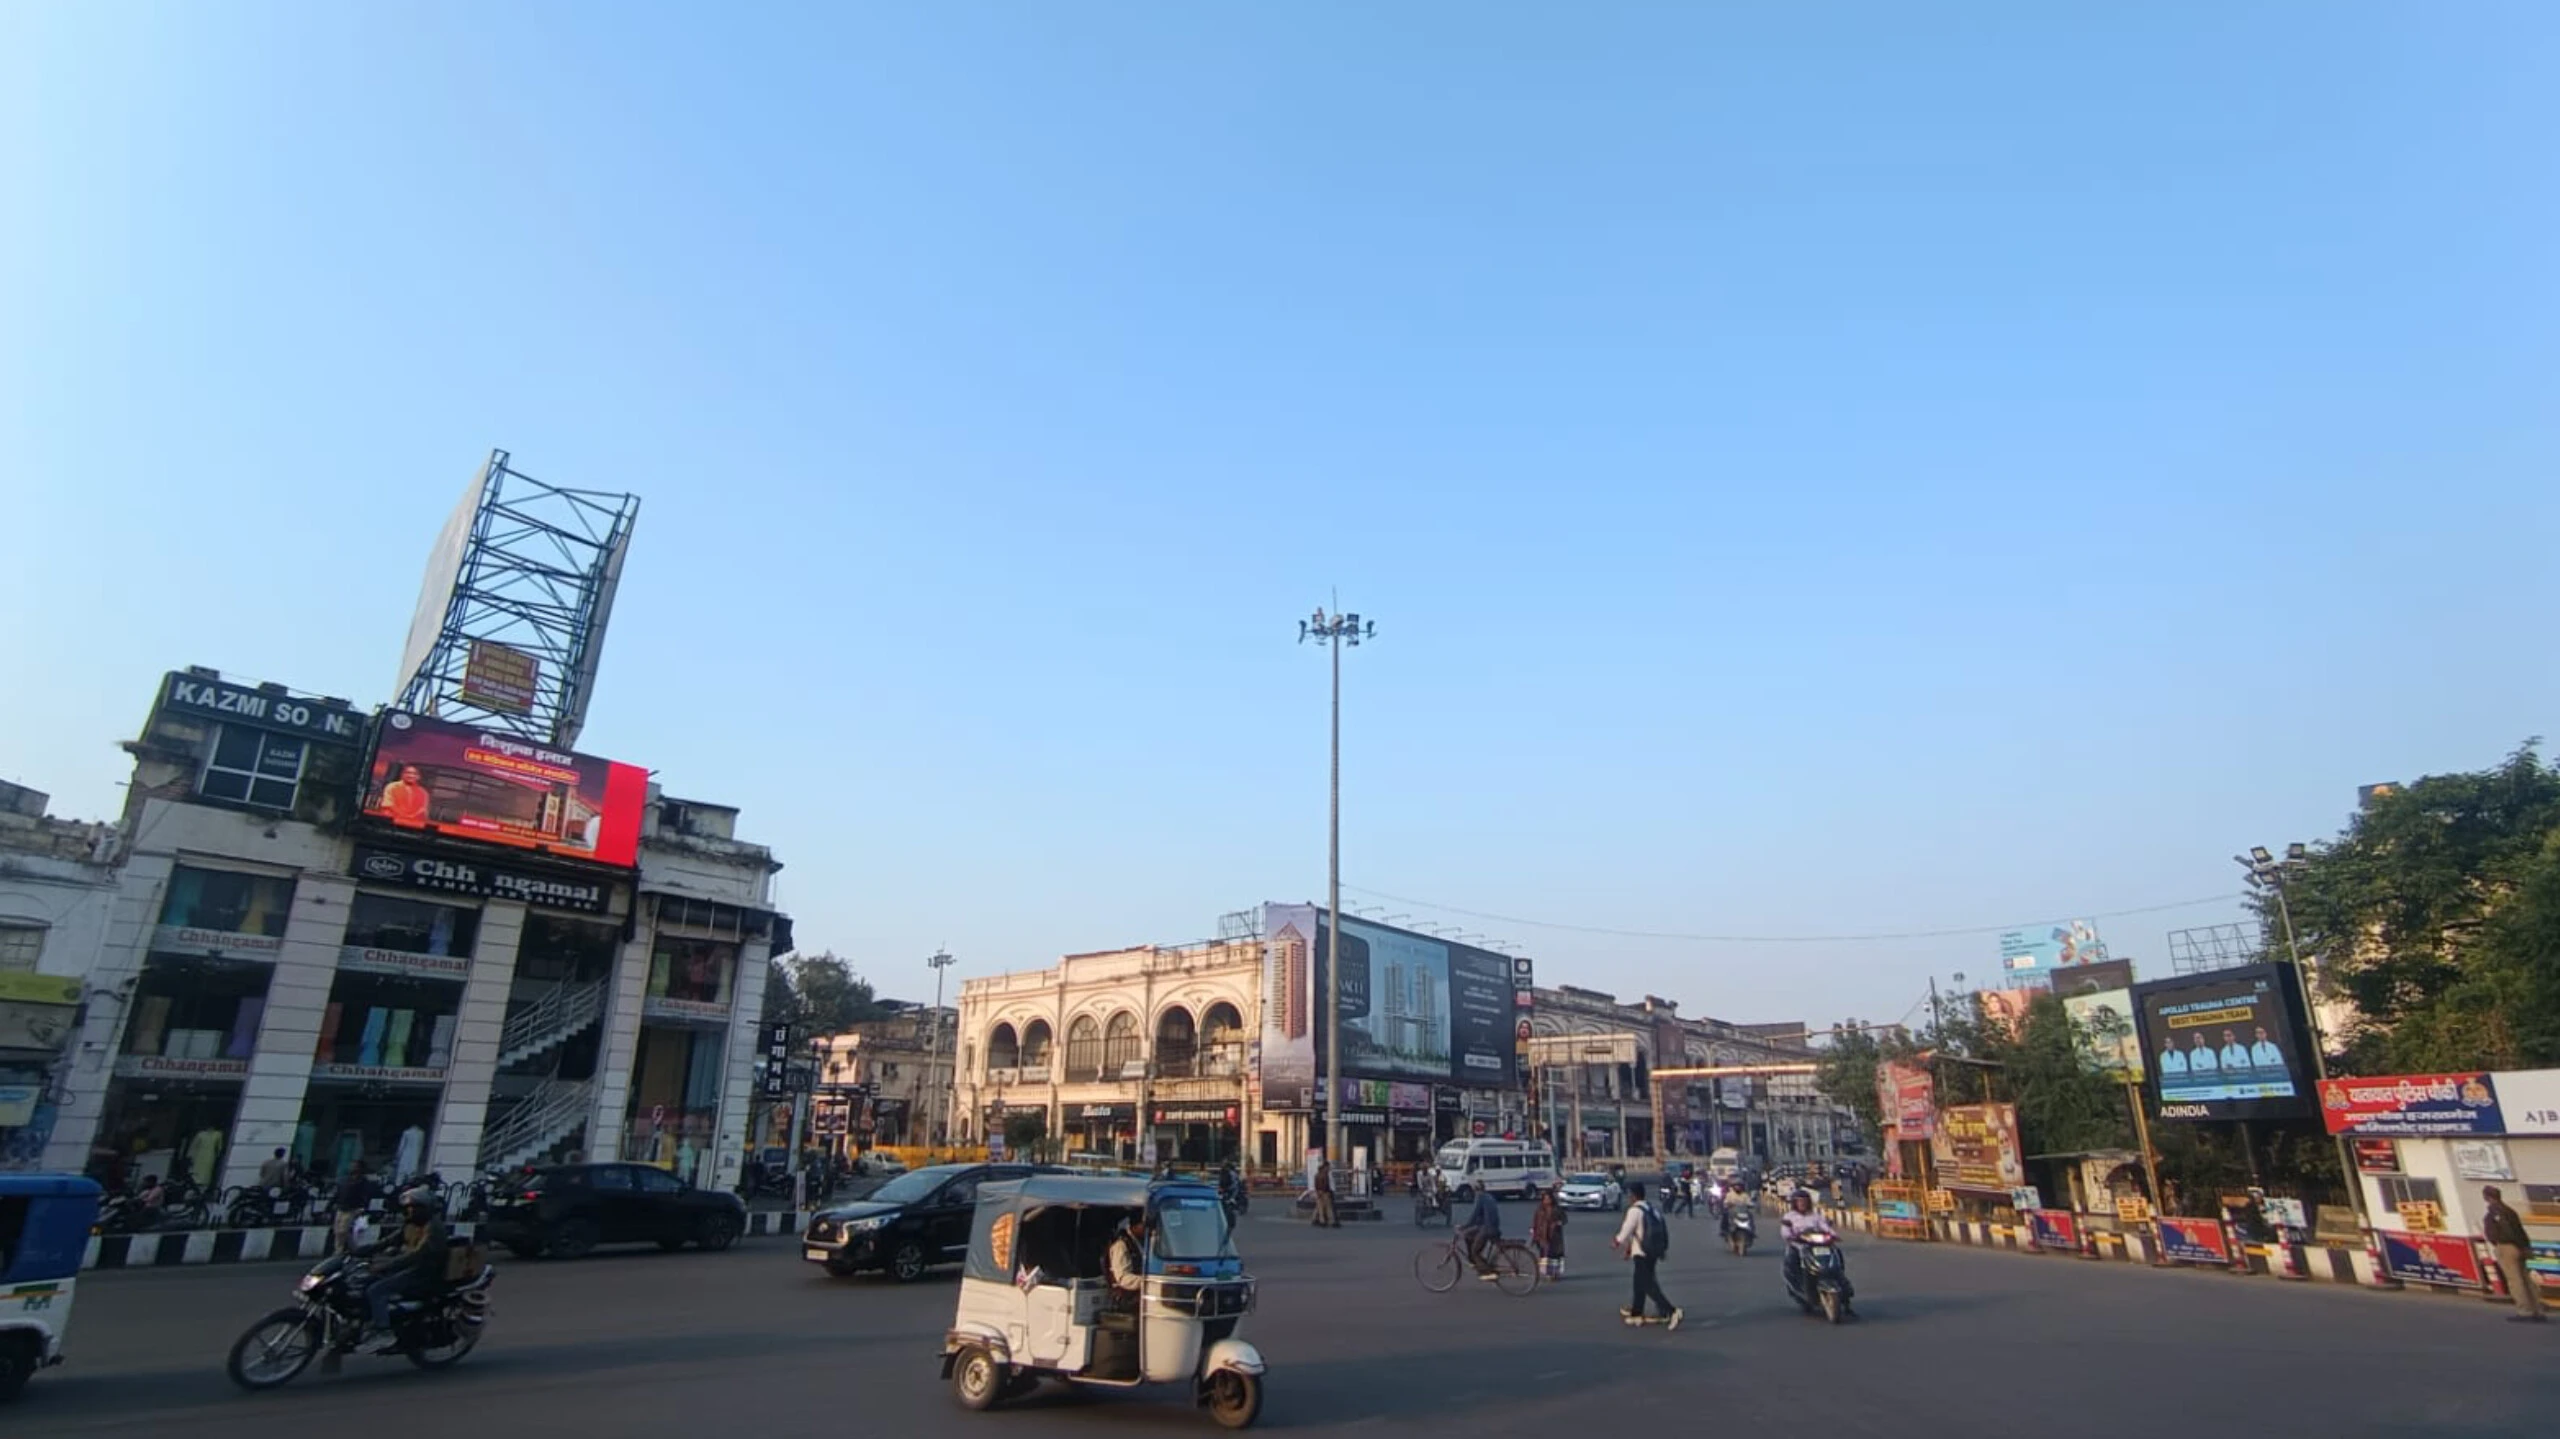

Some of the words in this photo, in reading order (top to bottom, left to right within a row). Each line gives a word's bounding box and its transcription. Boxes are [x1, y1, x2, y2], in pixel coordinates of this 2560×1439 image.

[174, 681, 267, 718] KAZMI
[180, 929, 282, 949] Chhangamal
[363, 949, 468, 971] Chhangamal
[142, 1057, 249, 1075] Chhangamal
[330, 1065, 444, 1079] Chhangamal
[2393, 1079, 2429, 1111] पुलिस
[2160, 1104, 2210, 1118] ADINDIA
